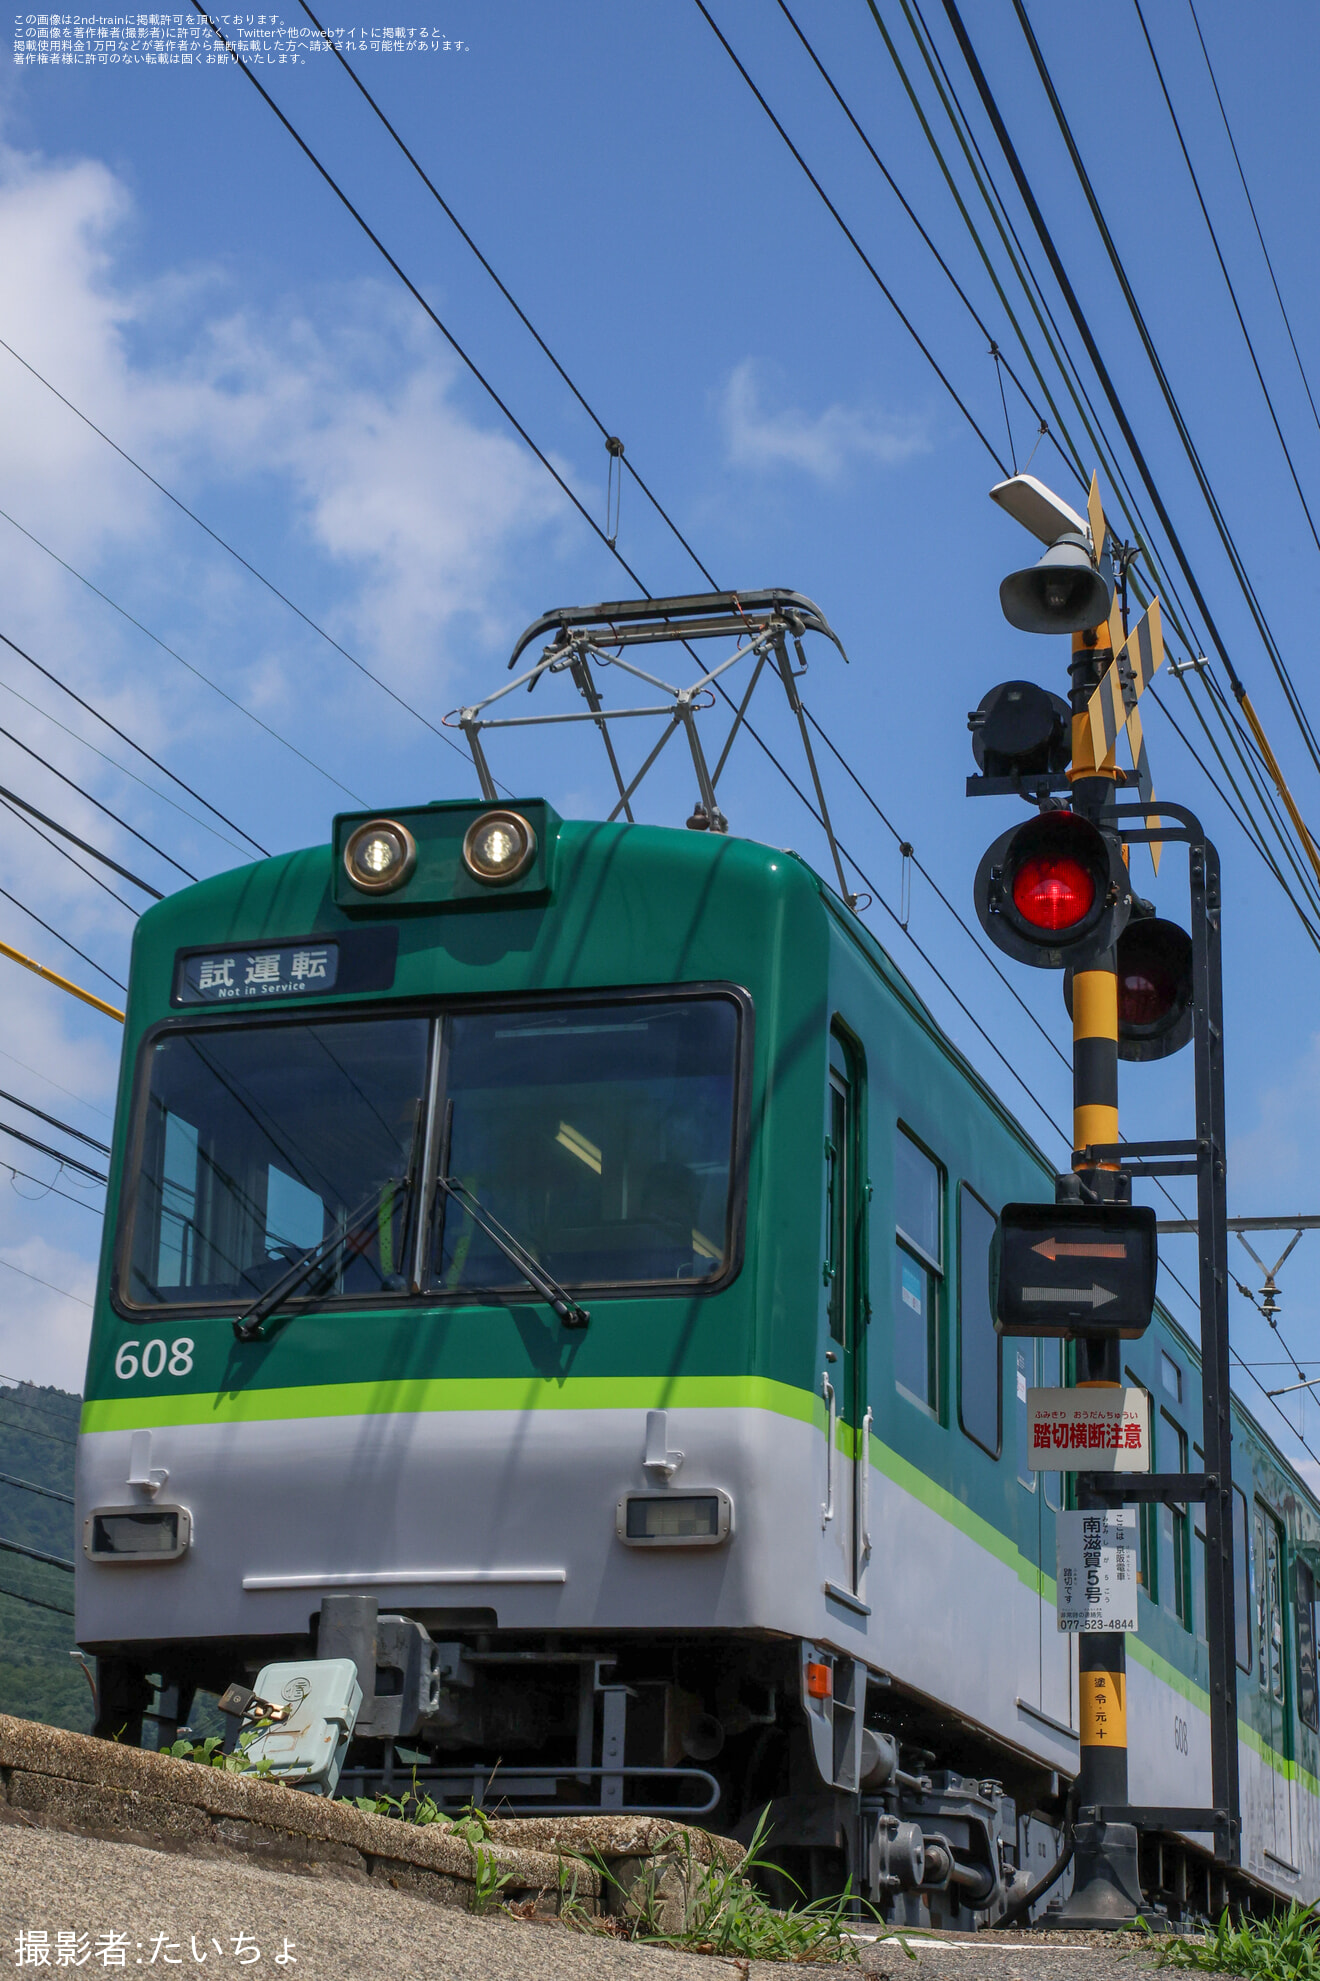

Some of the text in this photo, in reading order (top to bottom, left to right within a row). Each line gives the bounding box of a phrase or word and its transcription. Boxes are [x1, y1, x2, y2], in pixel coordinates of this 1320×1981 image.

[199, 950, 328, 990] 試運転
[218, 981, 306, 998] Not in Service
[115, 1337, 195, 1380] 608
[1035, 1410, 1139, 1420] ふみきり おうだんちゅうい
[1033, 1422, 1142, 1449] 踏切横断注意
[1083, 1516, 1102, 1603] 南滋賀5号
[1116, 1514, 1126, 1581] ここは 京阪電車
[1063, 1567, 1073, 1604] 踏切です
[1060, 1619, 1134, 1630] 077-523-4844
[1174, 1715, 1189, 1757] 608
